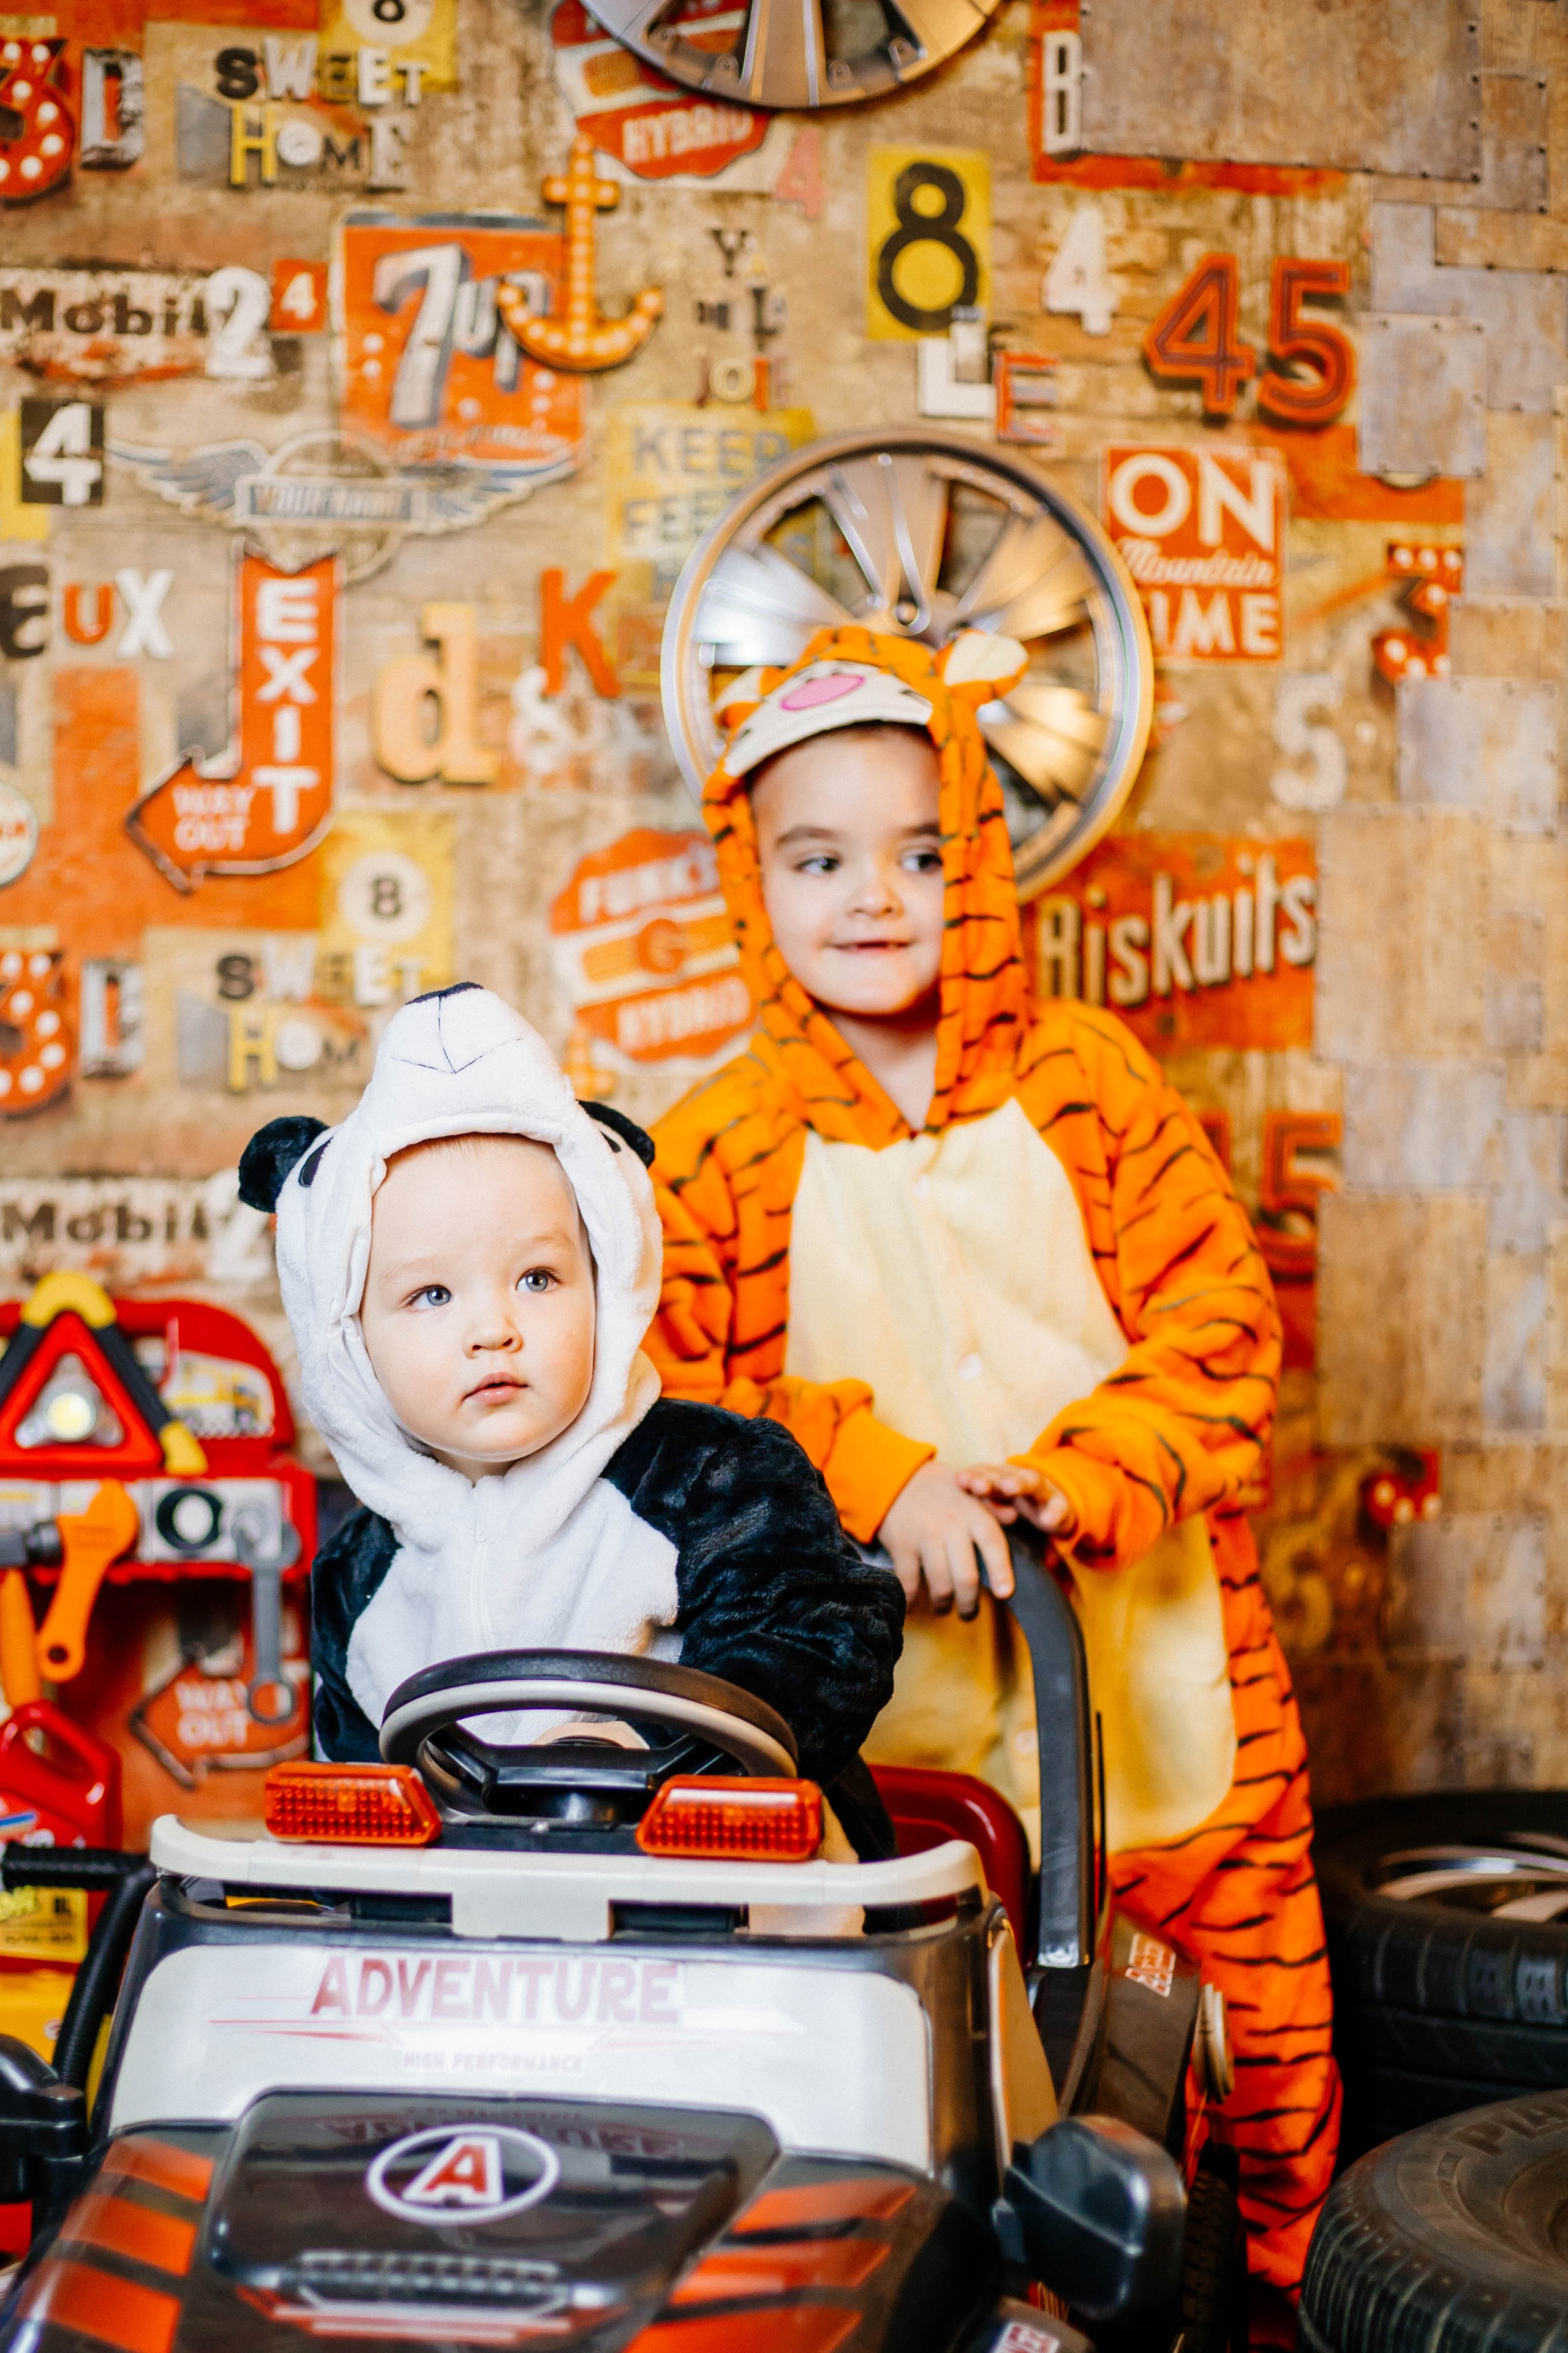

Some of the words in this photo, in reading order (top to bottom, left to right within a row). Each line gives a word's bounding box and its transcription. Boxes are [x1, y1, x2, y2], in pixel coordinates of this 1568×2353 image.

[216, 36, 431, 109] SWEET
[229, 104, 414, 189] HOME
[622, 104, 756, 164] HYBRID
[877, 162, 980, 332] 8
[1042, 203, 1118, 334] 4
[0, 285, 208, 337] Mobil
[204, 266, 271, 377] 2
[280, 271, 318, 320] 4
[1144, 252, 1358, 424] 45
[23, 402, 103, 506] 4
[1110, 452, 1275, 553] ON
[537, 567, 620, 700] K
[1139, 587, 1279, 658] IME
[251, 577, 322, 834] EXIT
[374, 602, 499, 785] d
[171, 784, 256, 817] WAY
[173, 815, 251, 853] OUT
[370, 872, 403, 921] 8
[216, 935, 426, 1006] SWEET
[637, 918, 687, 975] G
[228, 1006, 392, 1093] HOM
[176, 1709, 254, 1748] OUT
[309, 1954, 680, 2024] ADVENTURE
[451, 2051, 586, 2074] PERFORMANCE
